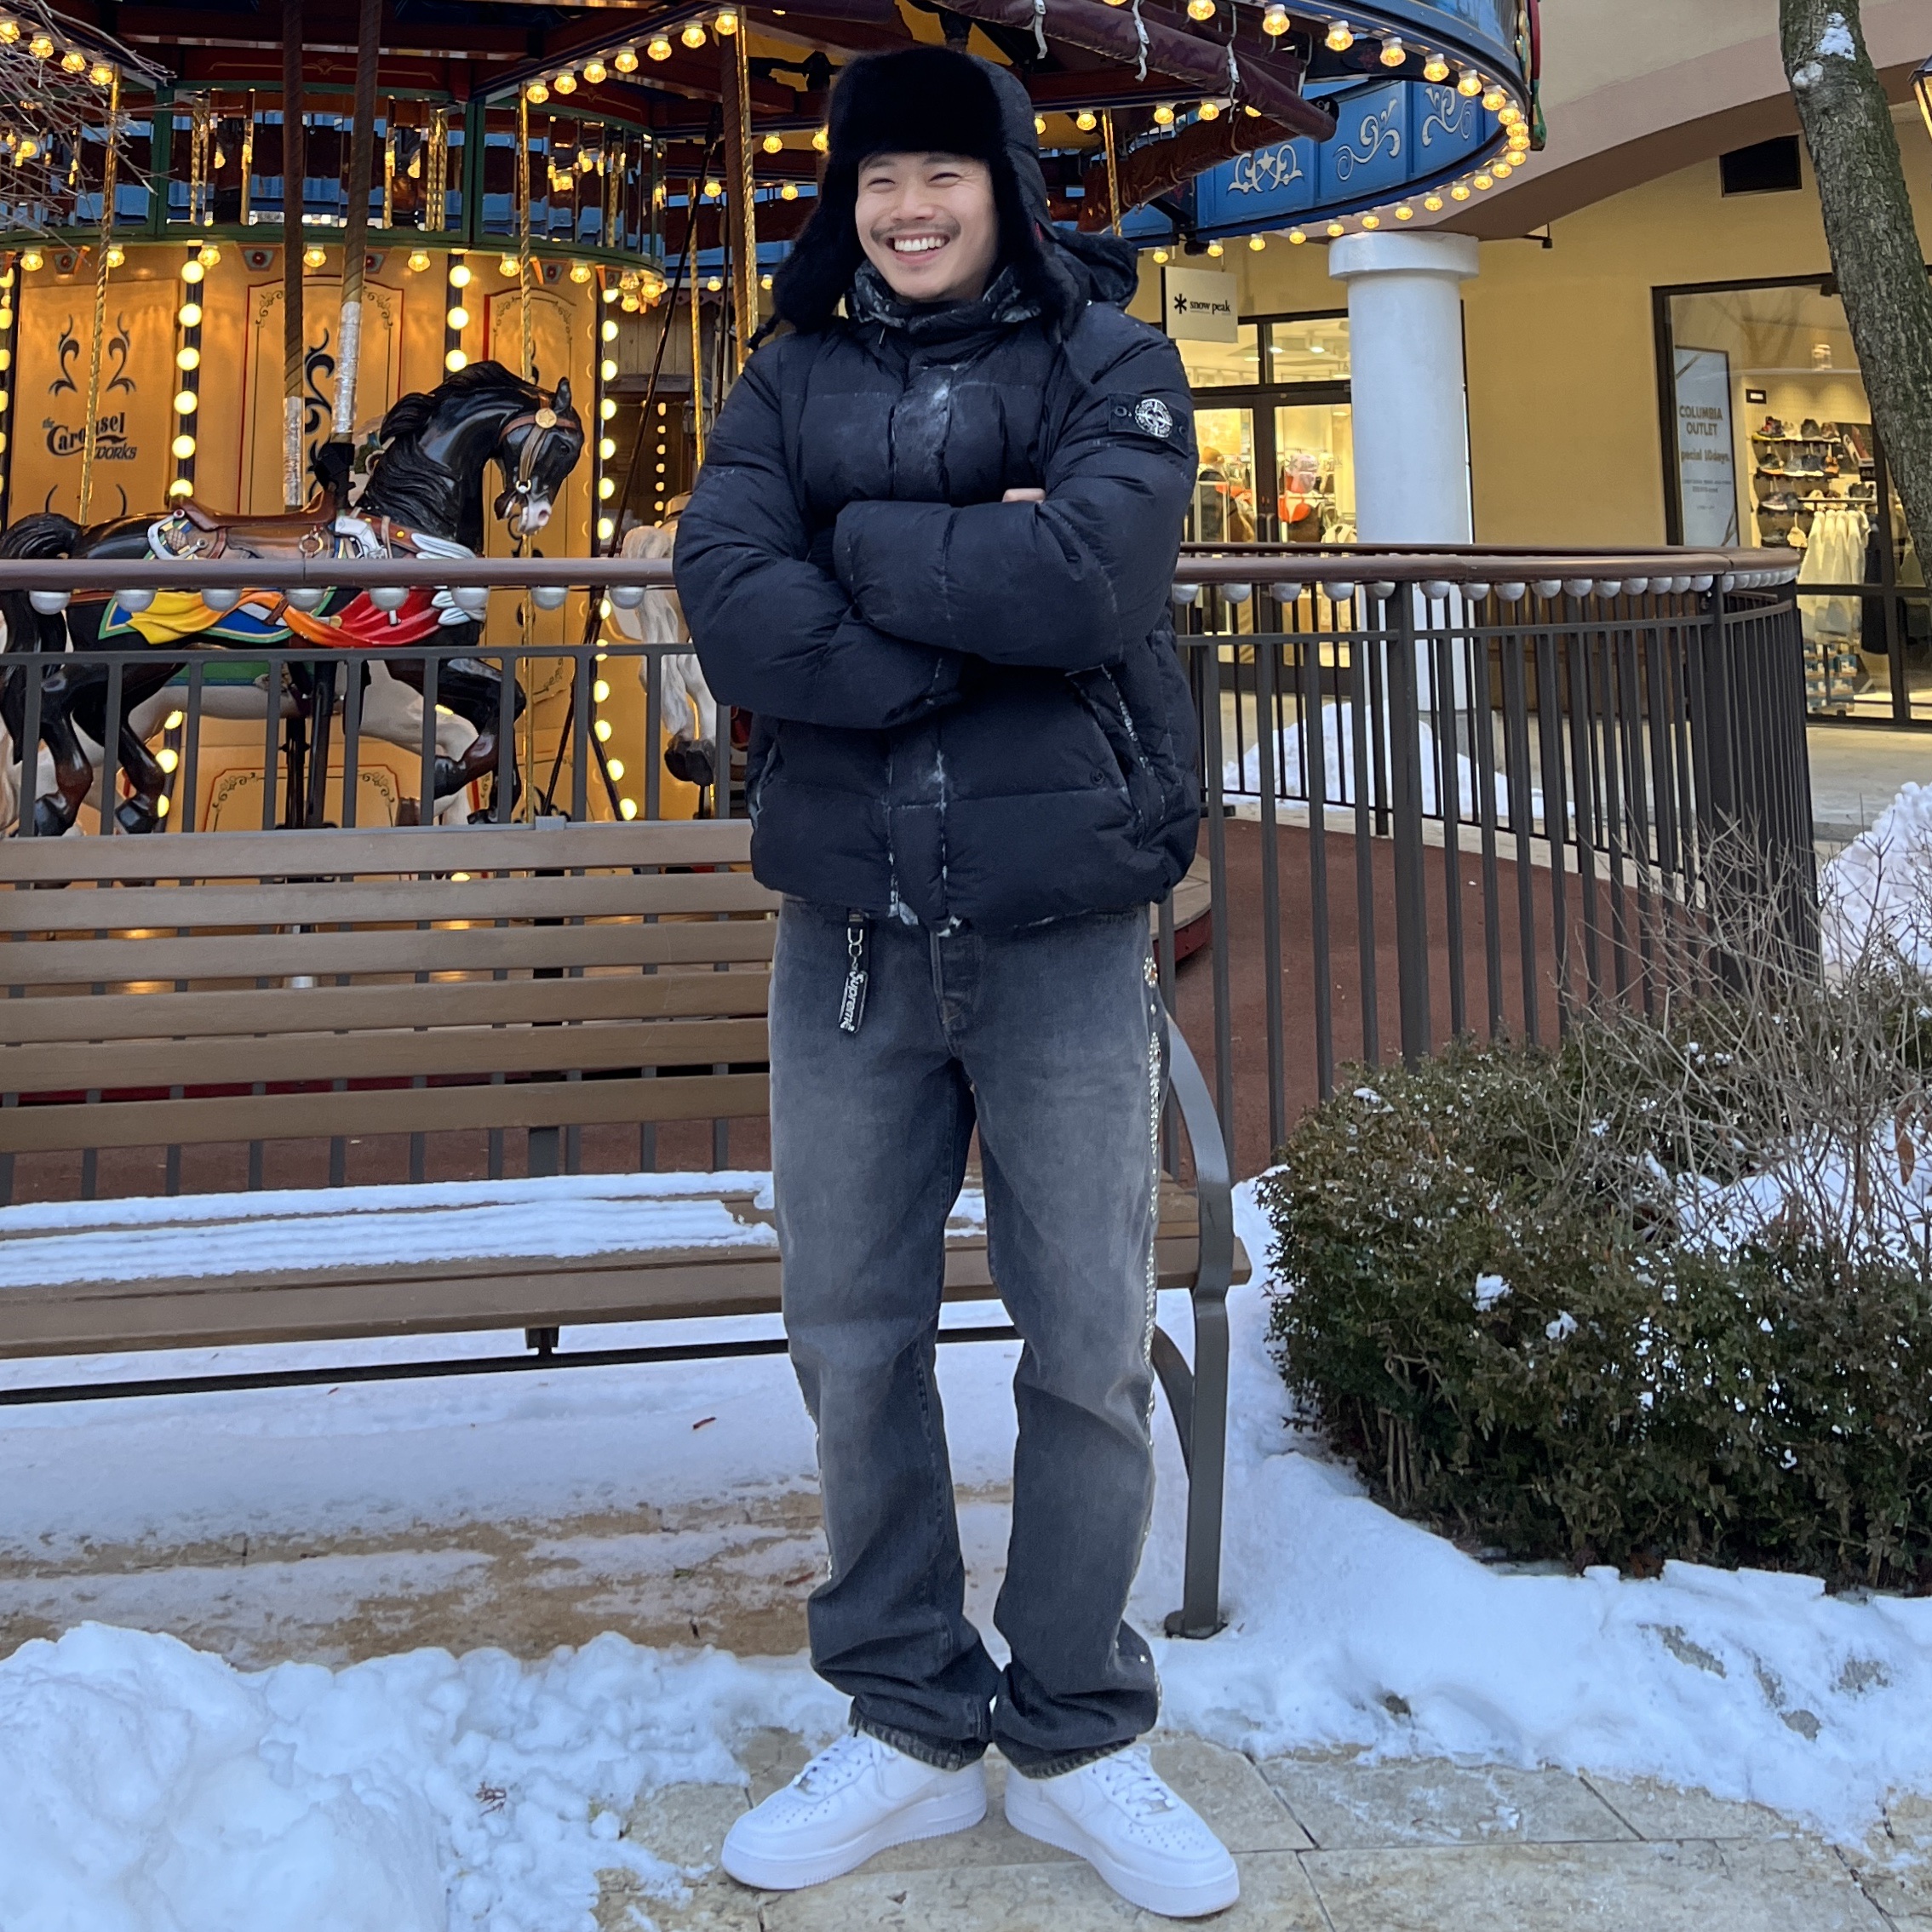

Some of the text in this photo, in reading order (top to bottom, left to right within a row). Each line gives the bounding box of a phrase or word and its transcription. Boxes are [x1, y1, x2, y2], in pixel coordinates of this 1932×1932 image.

[1190, 299, 1231, 315] snow peak
[1679, 404, 1723, 421] COLUMBIA
[1686, 421, 1717, 436] OUTLET
[840, 971, 864, 1032] Supreme
